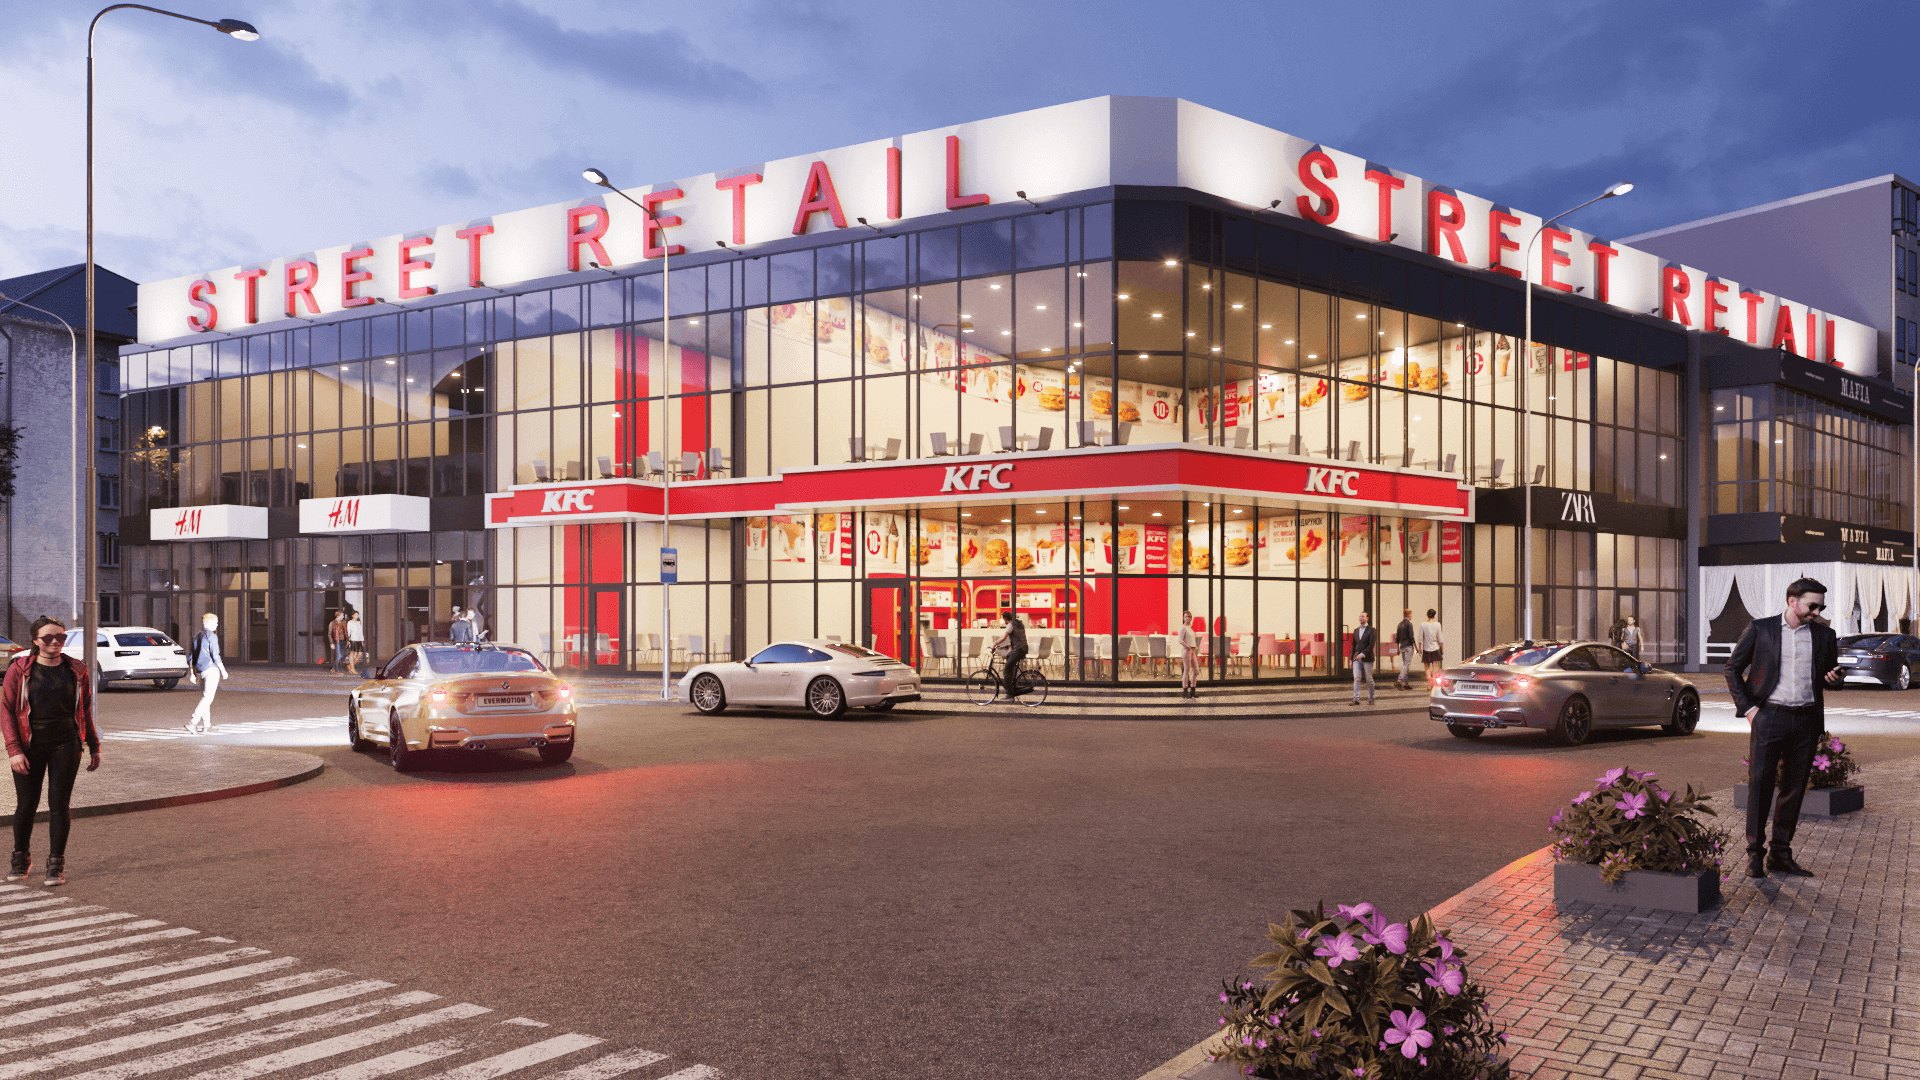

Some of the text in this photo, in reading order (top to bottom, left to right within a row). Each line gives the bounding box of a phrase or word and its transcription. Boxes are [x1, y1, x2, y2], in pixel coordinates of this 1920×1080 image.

[187, 135, 990, 333] STREET RETAIL
[1296, 150, 1845, 369] STREET RETAIL
[1840, 376, 1871, 405] MAFIA
[1156, 402, 1166, 418] 10
[941, 463, 1015, 492] KFC
[1303, 466, 1361, 497] KFC
[327, 498, 361, 529] H&M
[540, 488, 596, 513] KFC
[1560, 491, 1598, 524] ZARA
[174, 508, 203, 536] H&M
[1840, 527, 1870, 544] MAFIA
[1146, 535, 1167, 543] KFC
[1875, 547, 1895, 561] MAFIA
[482, 696, 527, 706] EVERMOTION
[1460, 683, 1490, 692] EVERMOTION
